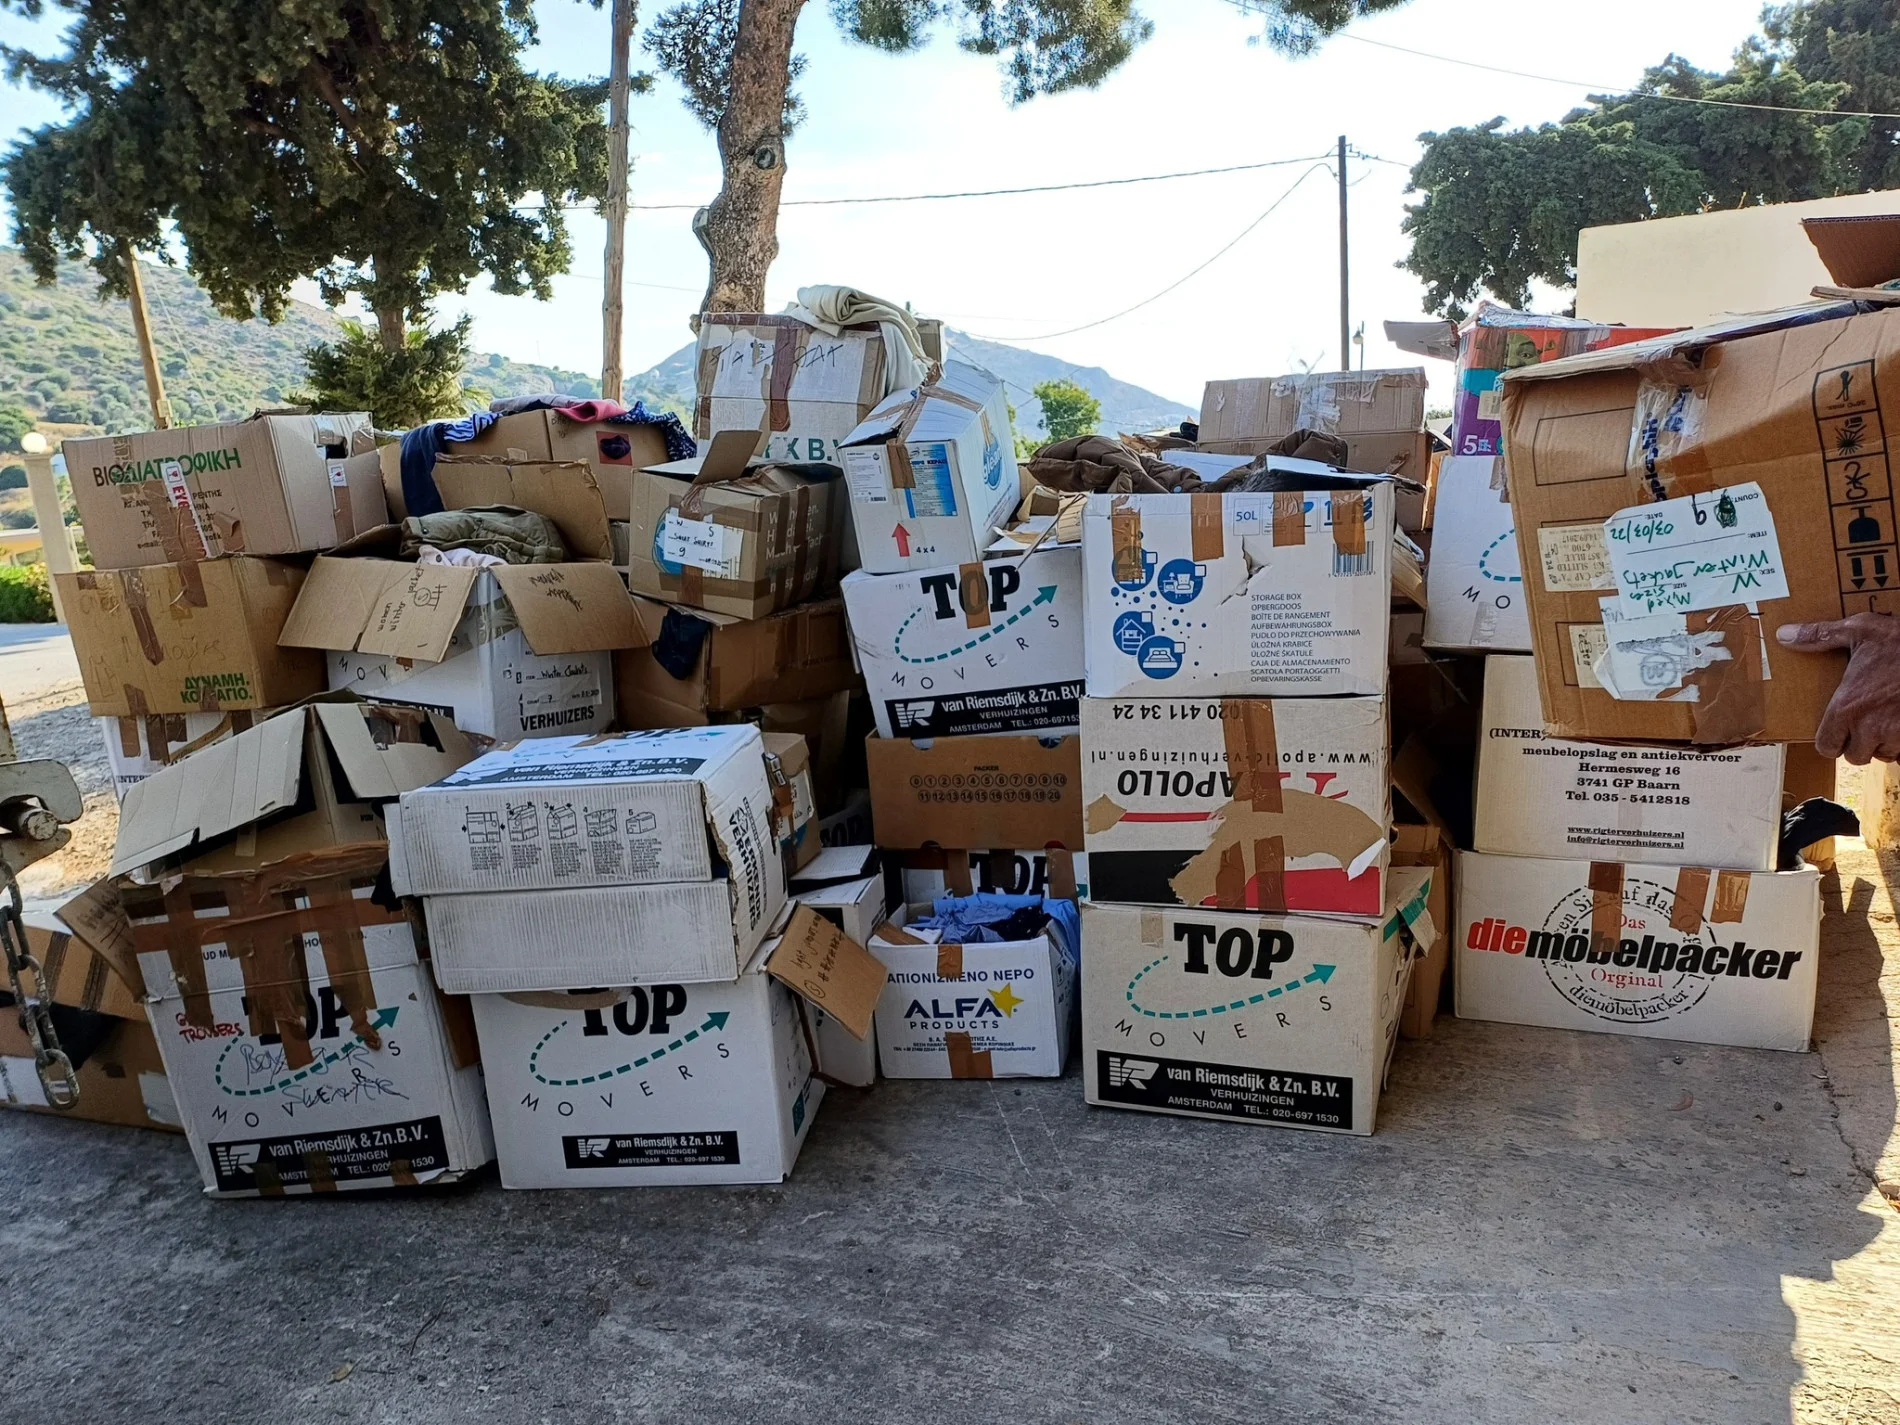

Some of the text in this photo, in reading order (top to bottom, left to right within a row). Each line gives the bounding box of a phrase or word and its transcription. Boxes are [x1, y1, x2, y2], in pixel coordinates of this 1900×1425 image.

[92, 447, 242, 487] ΒΙΟΔΙΑΤΟΦΙΚΗ
[1235, 510, 1258, 521] 50L
[1610, 520, 1674, 543] 03/03/22
[1692, 549, 1769, 578] Winter
[1574, 572, 1592, 581] CAP
[1731, 574, 1761, 594] W
[920, 564, 1020, 619] TOP
[1251, 593, 1285, 601] STORAGE
[1251, 602, 1302, 611] OPBERGDOOS
[1273, 612, 1283, 620] DE
[1285, 611, 1331, 619] RANGEMENT
[1250, 621, 1332, 630] AUFBEWAHRUNGSBOX
[1290, 629, 1361, 638] PRZECHOWYWANIA
[891, 614, 1060, 689] MOVERS
[1282, 640, 1313, 648] KRABICE
[1270, 659, 1280, 667] DE
[1282, 658, 1351, 667] ALMACENAMIENTO
[1250, 675, 1322, 683] OPBEVARINGSKASSE
[1284, 667, 1340, 675] PORTAOGGETTI
[941, 699, 965, 713] van
[965, 690, 1027, 711] Riemsdijk
[1028, 690, 1039, 703] &
[520, 704, 595, 731] VERHUIZERS
[979, 706, 1048, 720] VERHUIZINGEN
[1113, 704, 1135, 720] 24
[1140, 704, 1162, 720] 34
[1169, 704, 1201, 720] 411
[949, 721, 1002, 734] AMSTERDAM
[1522, 745, 1742, 763] meubelopslag en antiekvervoer
[1578, 762, 1681, 777] Hermesweg 16
[1117, 769, 1245, 799] APOLLO
[1576, 778, 1681, 790] 3741 GP Baarn
[1565, 790, 1691, 805] Tel. 035 5412818
[1173, 922, 1295, 980] TOP
[1466, 917, 1803, 981] diemöbelpacker
[567, 983, 687, 1037] TOP
[904, 997, 1003, 1019] ALFA
[1569, 985, 1690, 1020] diemöbelpacker
[910, 1020, 1000, 1030] PRODUCTS
[1114, 995, 1333, 1048] MOVERS
[521, 1042, 730, 1117] MOVERS
[1167, 1067, 1340, 1098] van Riemsdijk & Zn. B.V.
[1210, 1087, 1295, 1107] VERHUIZINGEN
[1167, 1095, 1340, 1124] AMSTERDAM TEL.: 020-697 1530
[269, 1144, 293, 1158] van
[295, 1133, 358, 1155] Riemsdijk
[360, 1132, 372, 1147] &
[615, 1134, 724, 1149] van Riemsdijk & Zn. B.V.
[618, 1156, 661, 1164] AMSTERDAM
[644, 1148, 698, 1156] VERHUIZINGEN
